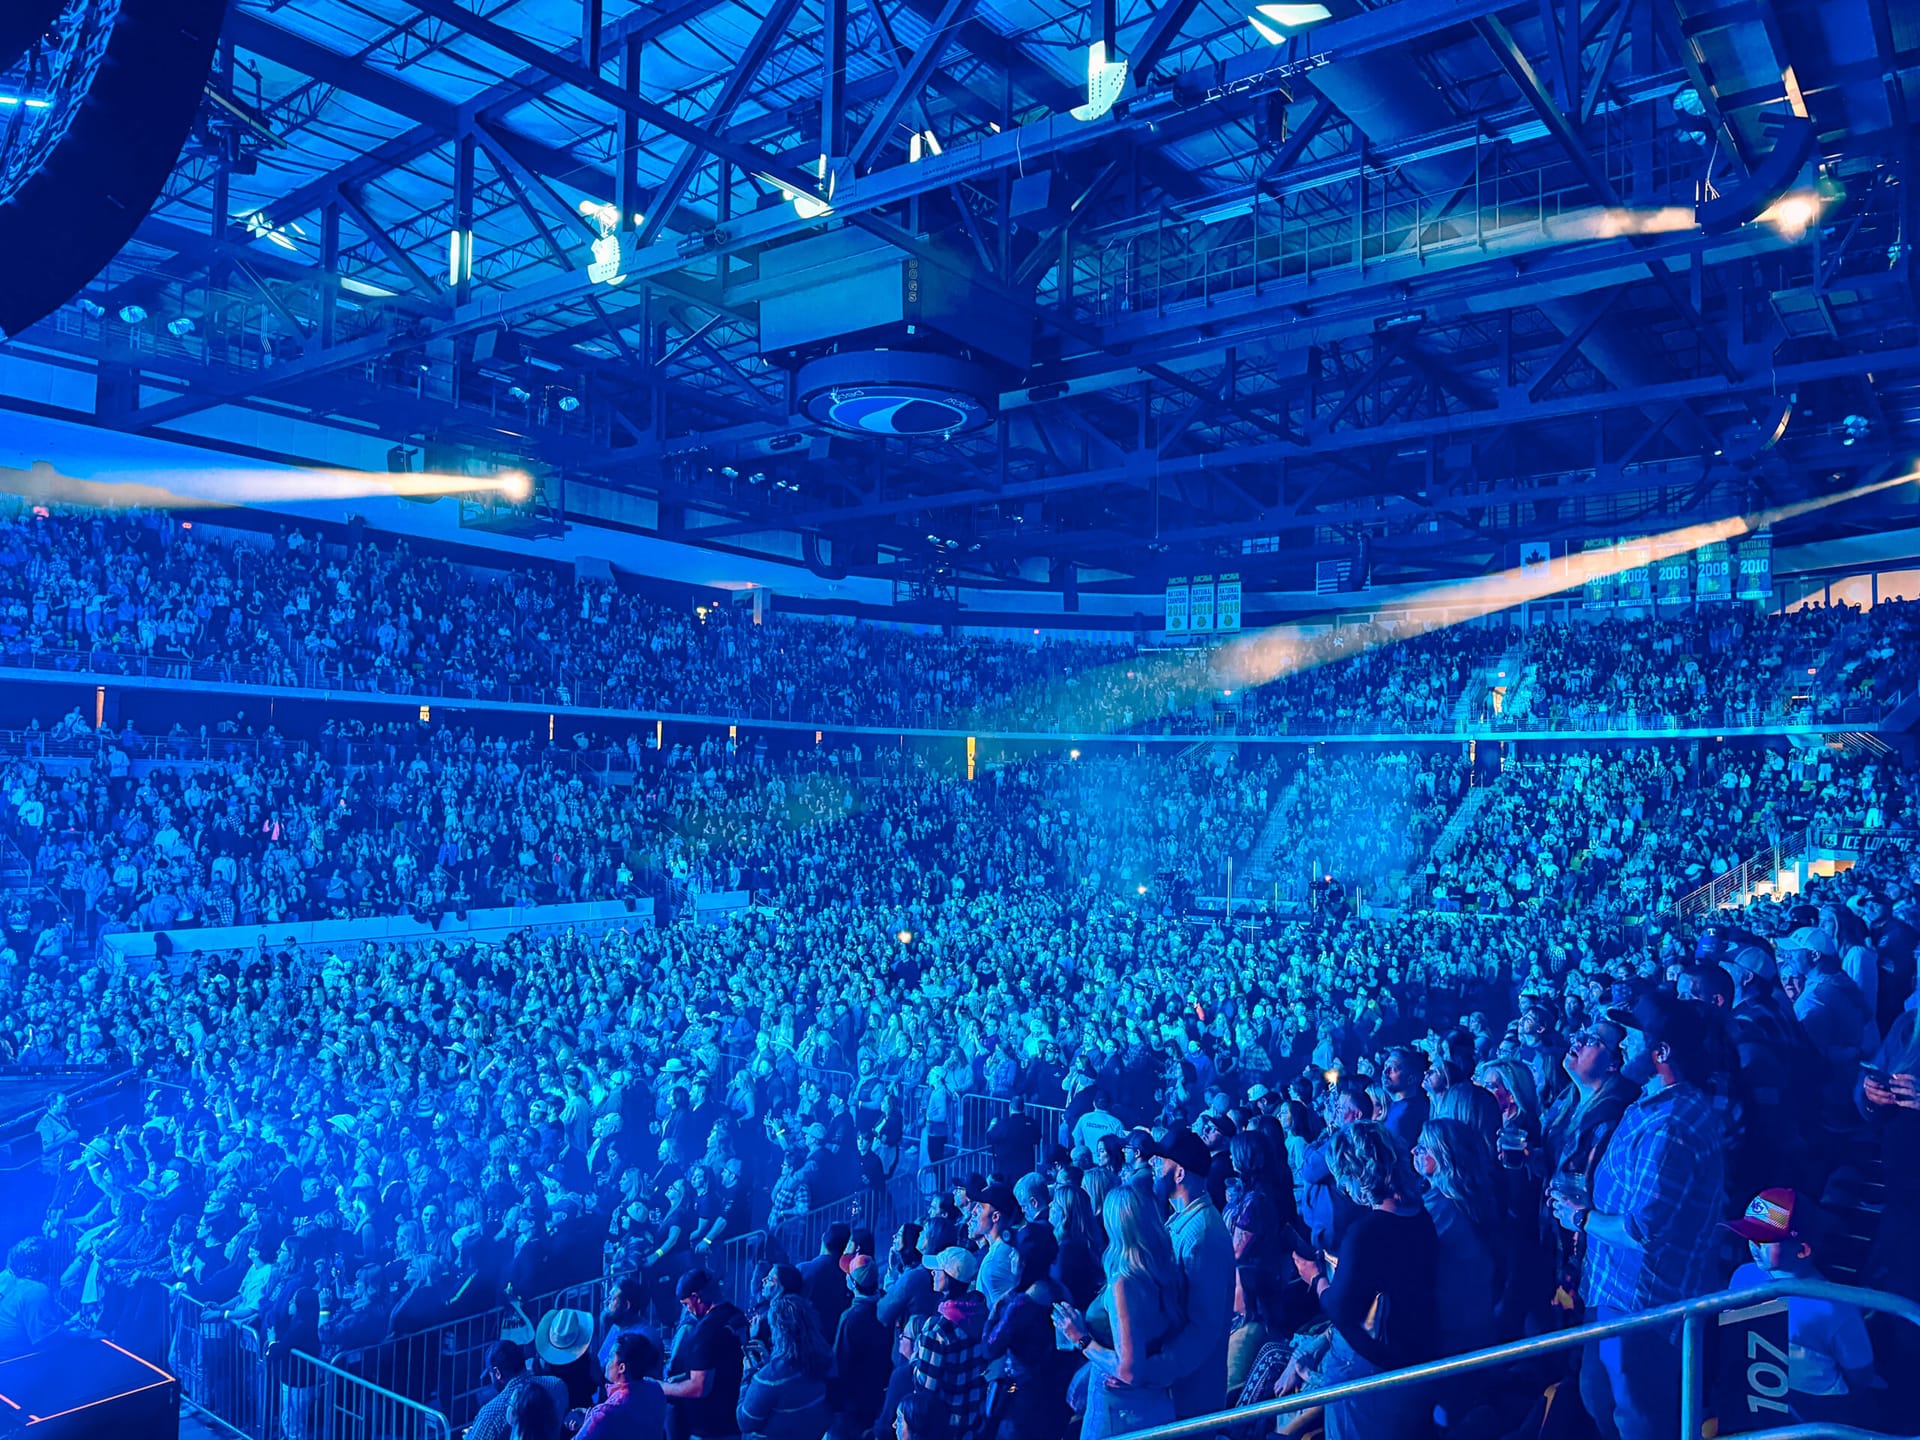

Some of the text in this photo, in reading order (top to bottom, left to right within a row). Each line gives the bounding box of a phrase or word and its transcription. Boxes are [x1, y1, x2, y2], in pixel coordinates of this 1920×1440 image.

[1658, 566, 1688, 581] 2003
[1697, 561, 1729, 577] 2008
[1739, 558, 1769, 574] 2010
[1620, 568, 1649, 583] 2002
[1842, 835, 1862, 849] ICE
[1747, 1331, 1789, 1413] 107
